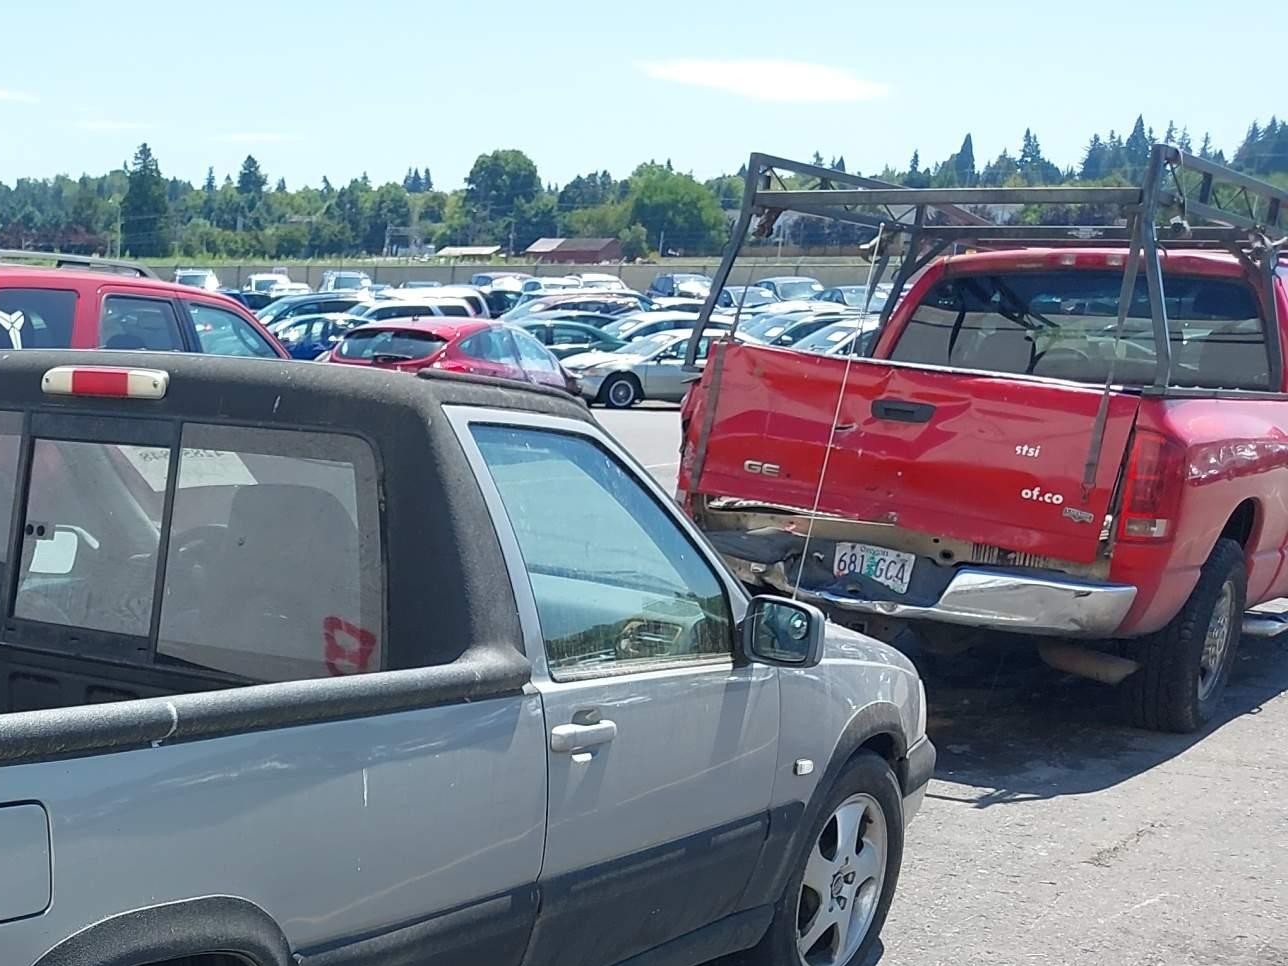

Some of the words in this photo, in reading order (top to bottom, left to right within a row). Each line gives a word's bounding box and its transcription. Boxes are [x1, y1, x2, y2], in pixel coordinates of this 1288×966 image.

[743, 460, 780, 477] GE
[1021, 487, 1063, 504] of.co
[838, 552, 865, 575] 681
[874, 558, 906, 584] GCA
